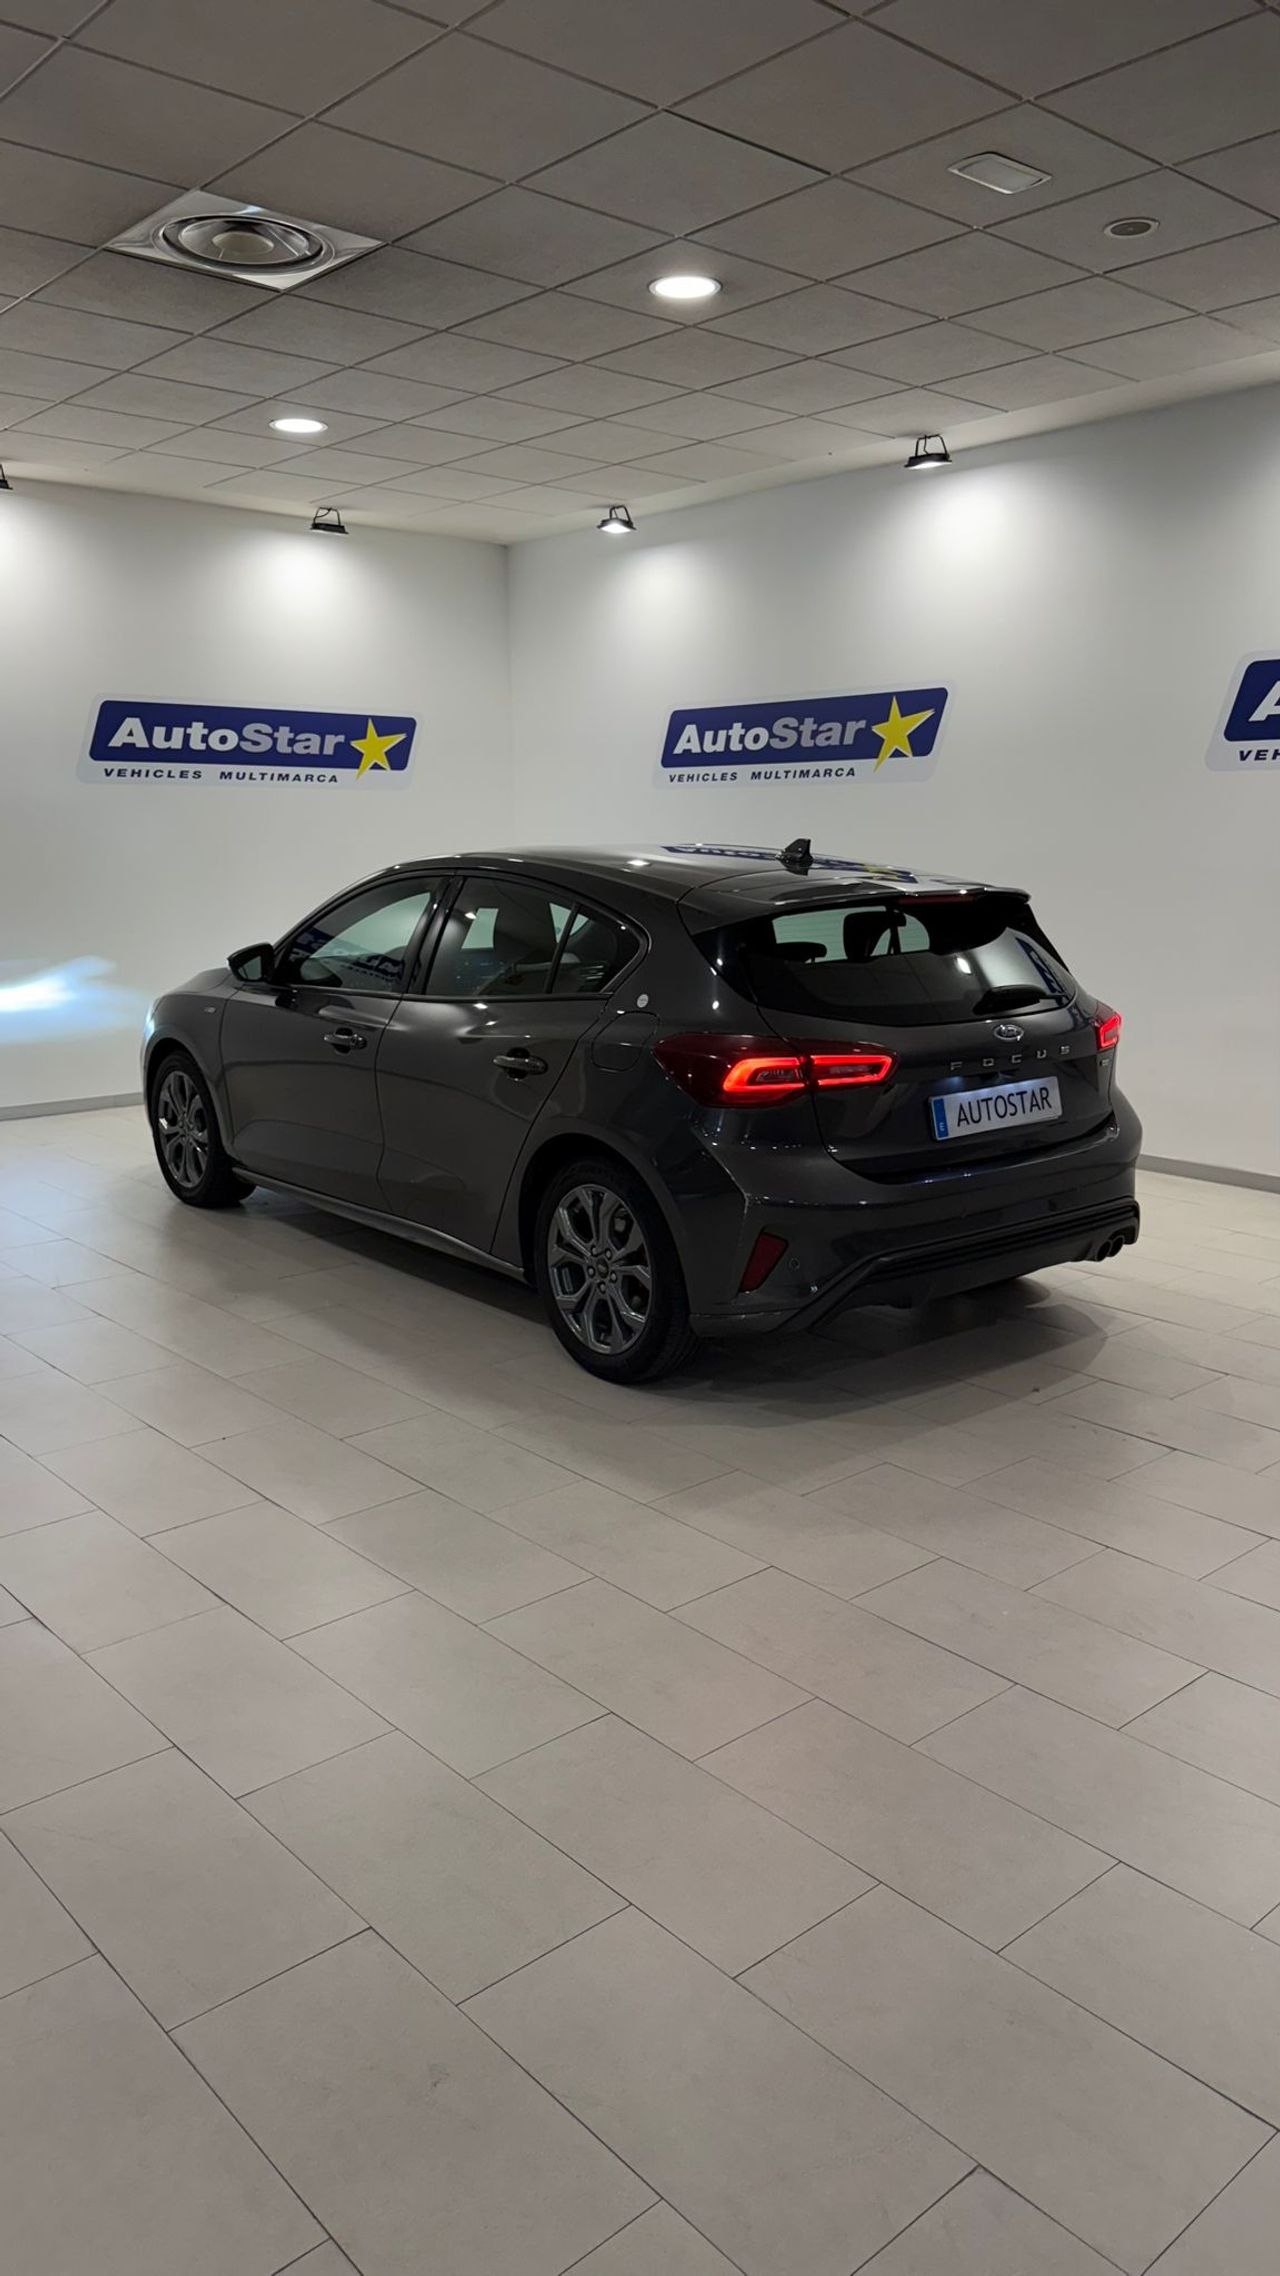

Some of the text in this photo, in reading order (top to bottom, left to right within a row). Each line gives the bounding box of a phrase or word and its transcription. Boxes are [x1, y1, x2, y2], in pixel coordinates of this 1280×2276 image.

[107, 717, 344, 755] AutoStar
[673, 716, 865, 754] AutoStar
[104, 767, 339, 784] VEHICLES MULTIMARCA
[668, 767, 857, 783] VEHICLES MULTIMARCA
[951, 1045, 1070, 1070] FOCUS
[957, 1087, 1052, 1126] AUTOSTAR
